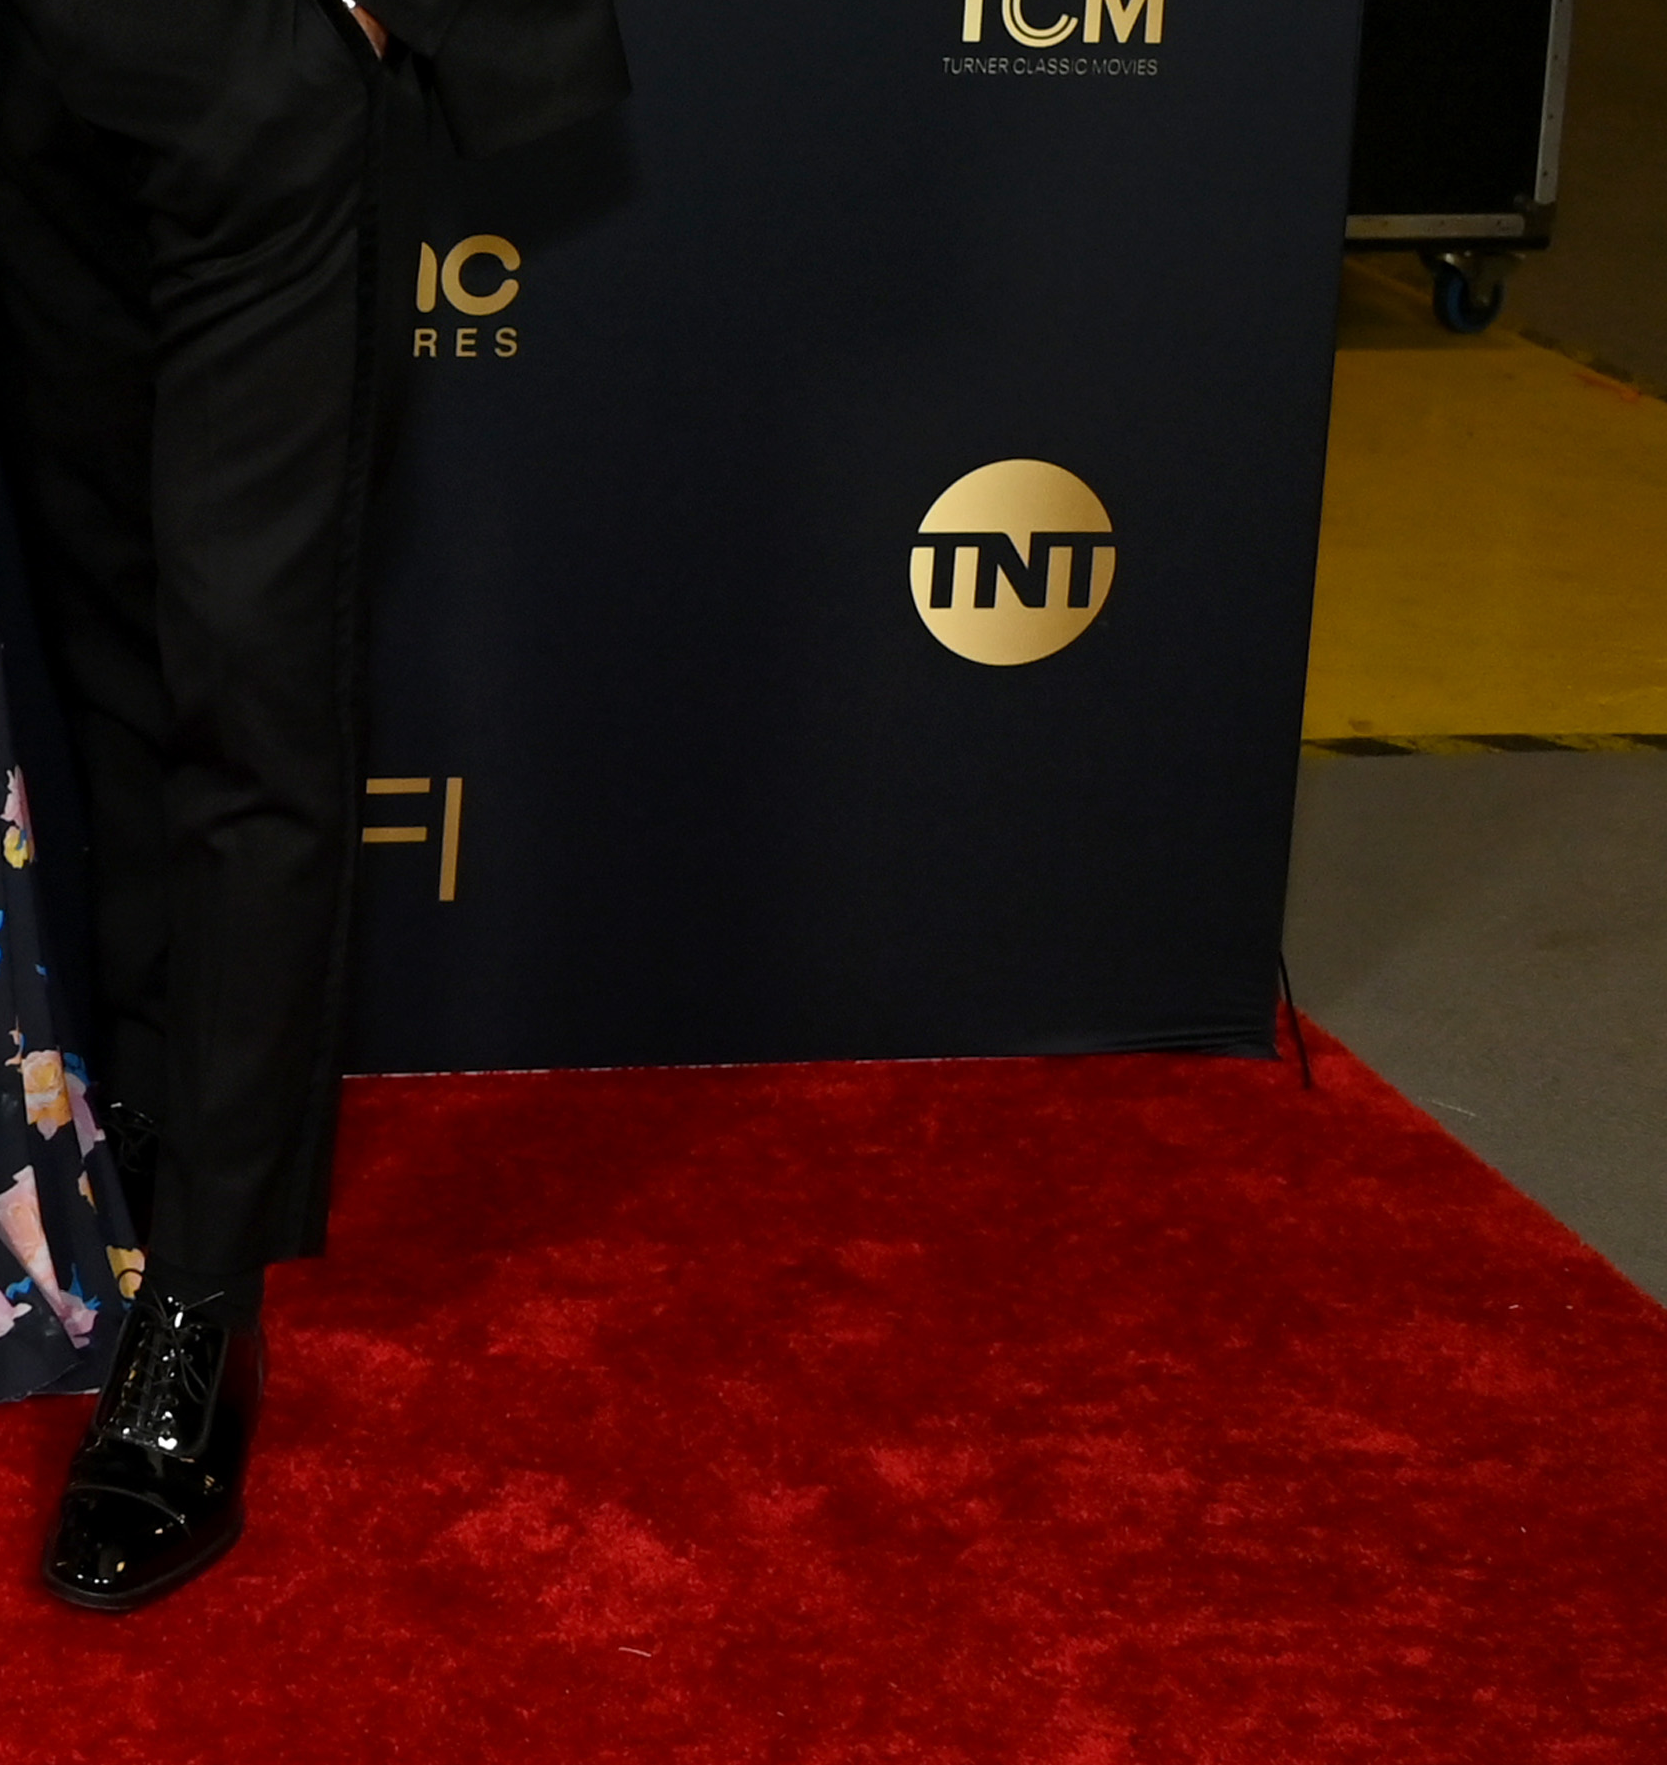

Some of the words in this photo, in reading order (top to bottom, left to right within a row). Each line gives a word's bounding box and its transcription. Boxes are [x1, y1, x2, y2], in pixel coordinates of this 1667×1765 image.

[942, 56, 1009, 75] TURNER
[1013, 56, 1088, 76] CLASSIC
[1092, 57, 1158, 76] MOVIES
[909, 532, 1117, 610] TNT
[362, 776, 463, 902] FI
